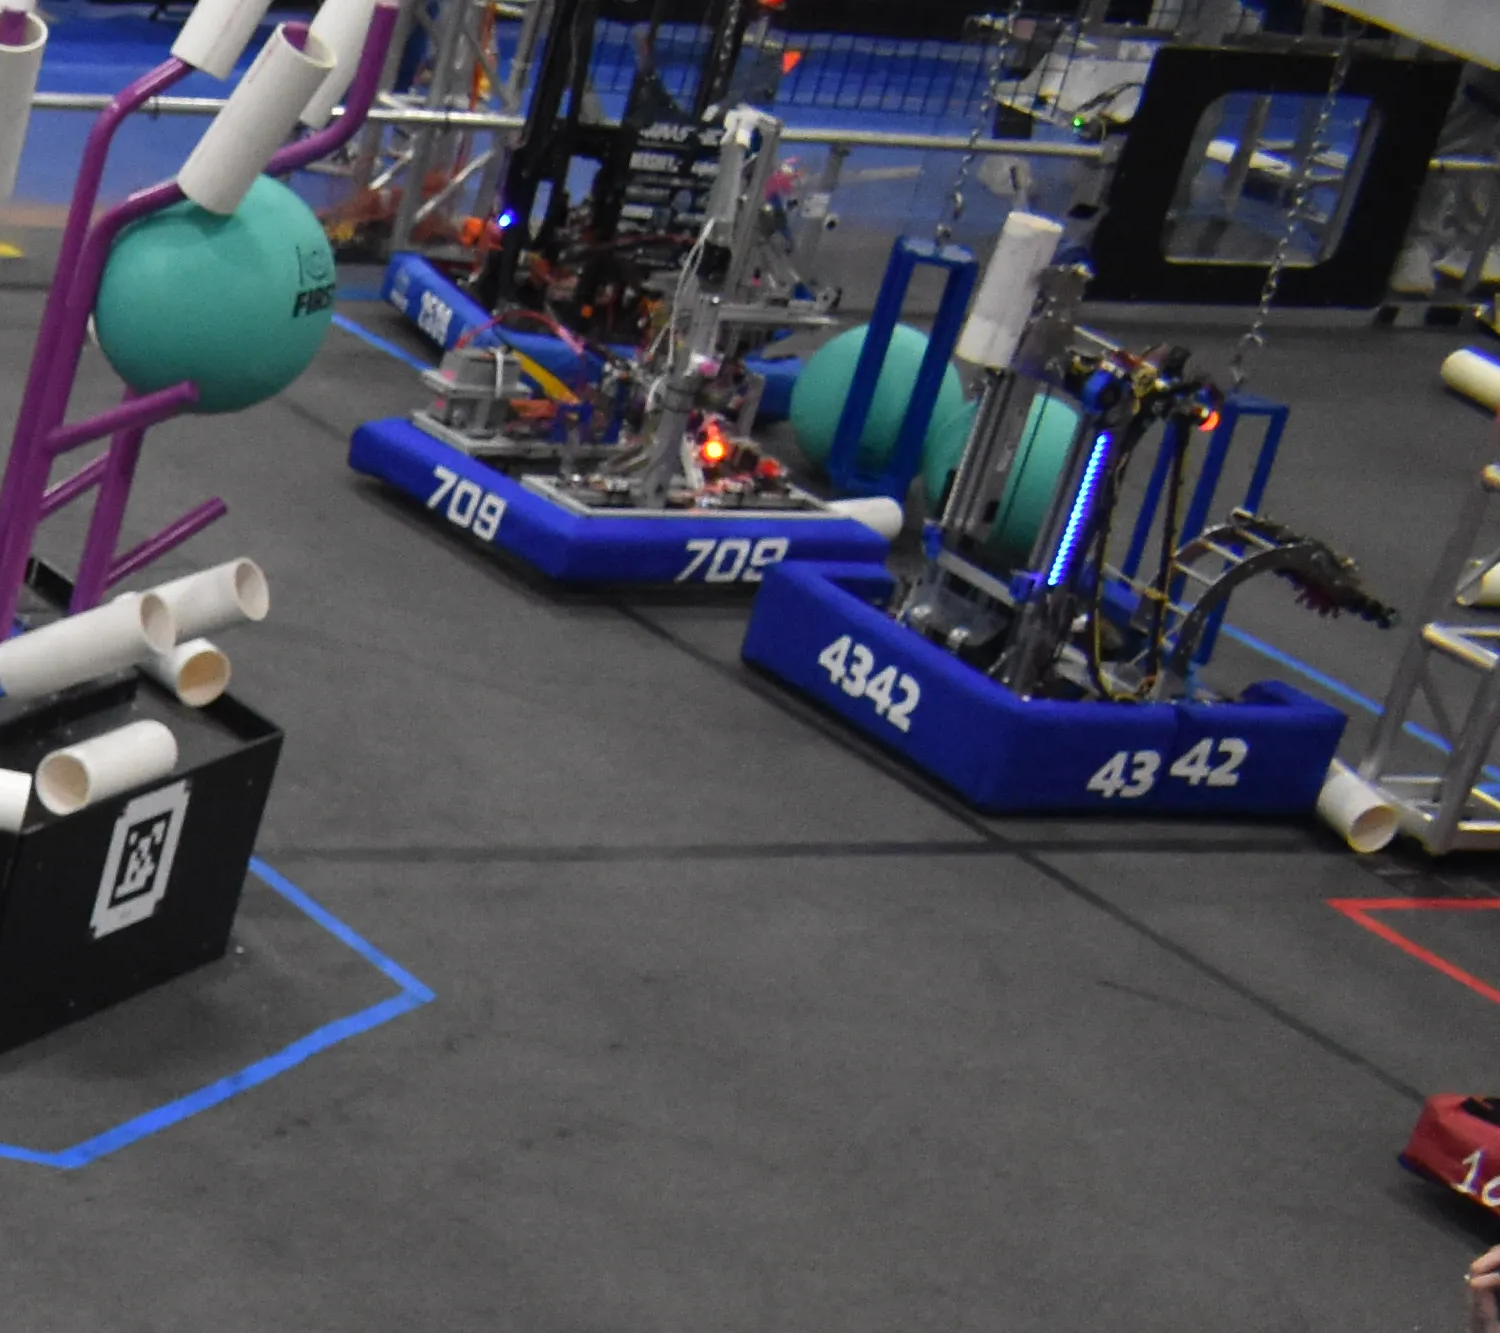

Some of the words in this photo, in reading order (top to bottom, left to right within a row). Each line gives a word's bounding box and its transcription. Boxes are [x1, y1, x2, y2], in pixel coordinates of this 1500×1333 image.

[426, 465, 508, 541] 709
[674, 536, 789, 583] 709
[817, 633, 921, 732] 4342
